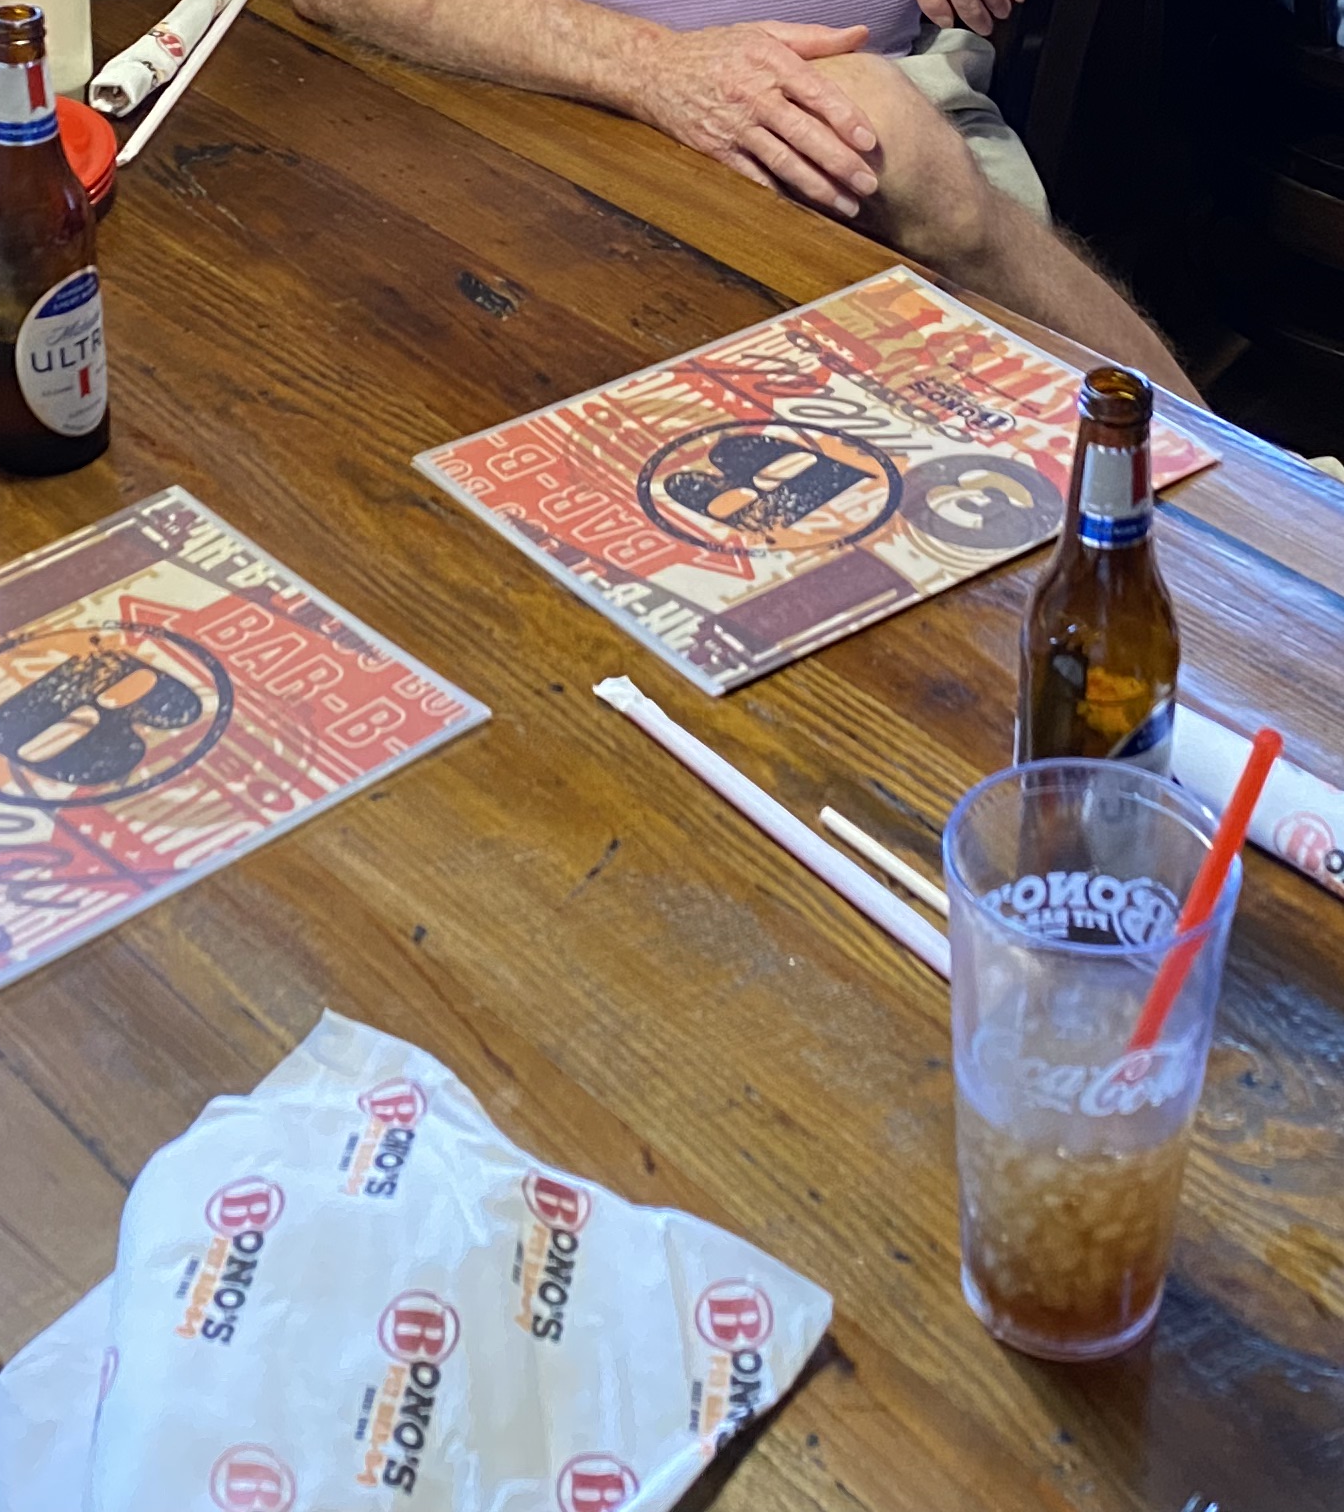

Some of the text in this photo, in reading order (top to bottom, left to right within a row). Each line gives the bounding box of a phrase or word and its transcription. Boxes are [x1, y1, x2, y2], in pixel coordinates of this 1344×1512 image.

[477, 432, 678, 571] BAR-B-
[921, 469, 1033, 527] 3
[191, 600, 414, 755] BAR-B-
[201, 1190, 270, 1345] BONO'S
[530, 1174, 580, 1346] BONO'S
[382, 1307, 447, 1496] BONO'S
